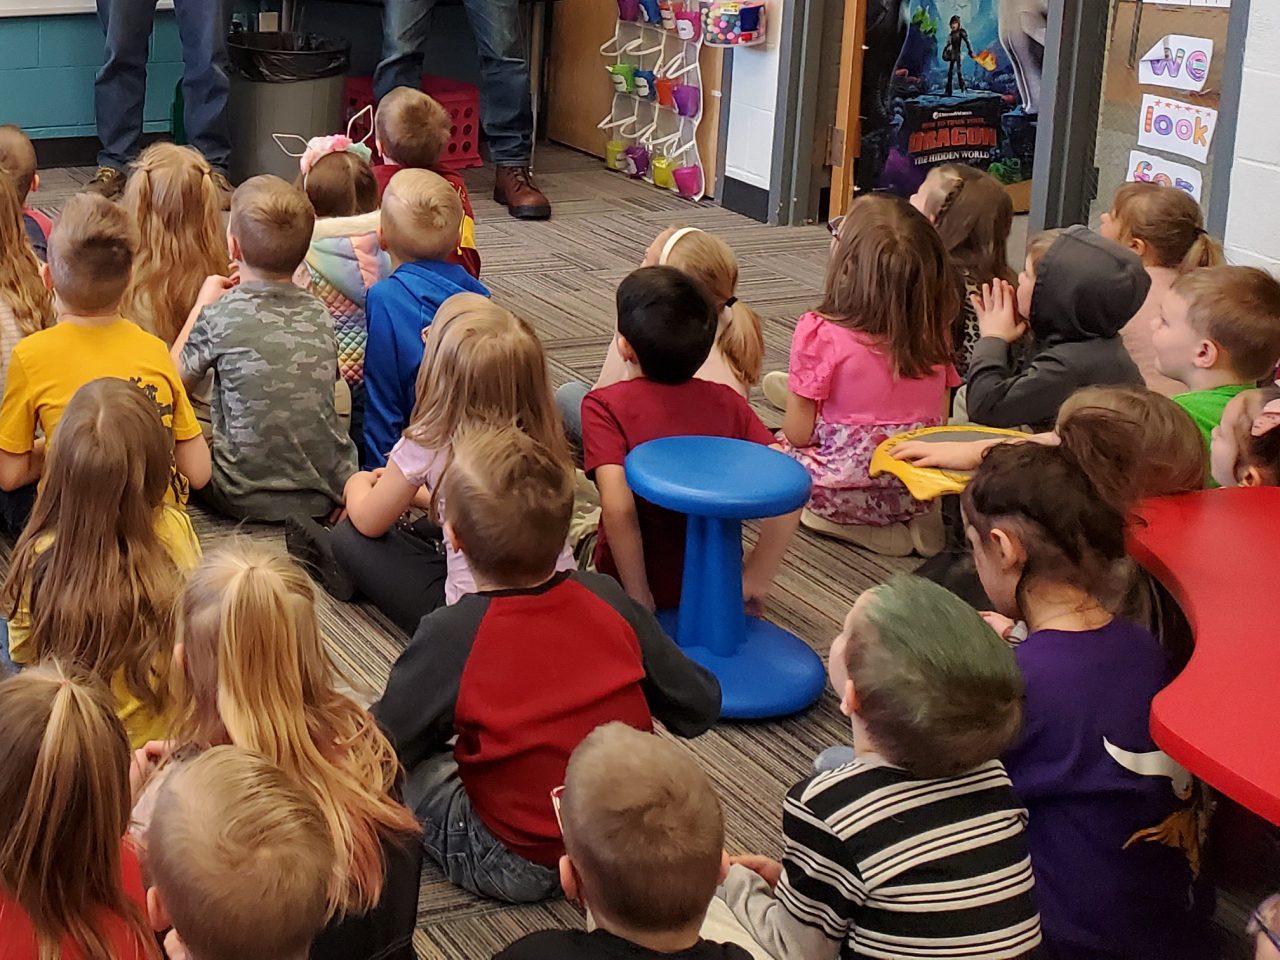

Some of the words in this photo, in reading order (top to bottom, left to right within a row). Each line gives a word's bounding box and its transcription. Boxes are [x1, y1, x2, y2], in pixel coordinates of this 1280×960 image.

[1150, 47, 1208, 83] we
[907, 126, 997, 154] DRAGON
[1144, 105, 1209, 148] look
[914, 156, 928, 166] THE
[928, 151, 960, 163] HIDDEN
[960, 150, 990, 159] WORLD
